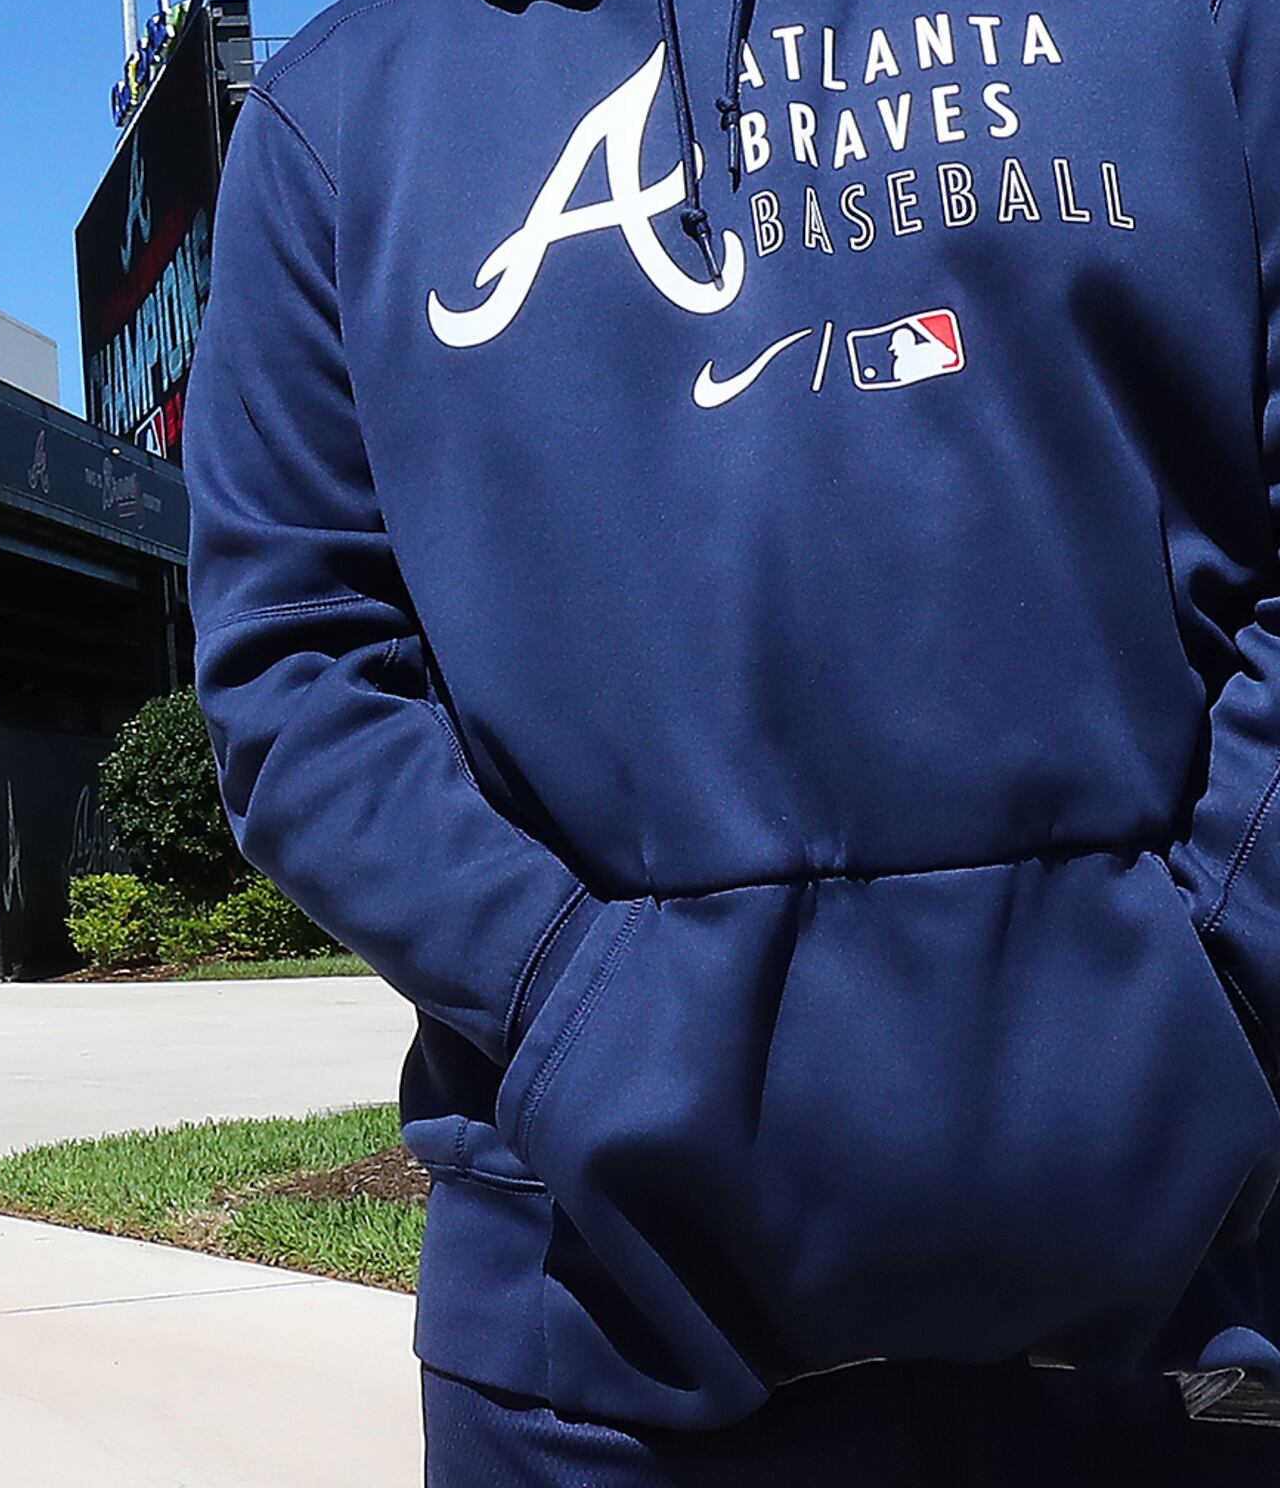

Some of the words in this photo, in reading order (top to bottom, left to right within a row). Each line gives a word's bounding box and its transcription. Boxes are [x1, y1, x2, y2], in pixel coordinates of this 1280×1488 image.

[740, 13, 1063, 90] ATLANTA
[740, 81, 1020, 174] BRAVES
[749, 158, 1136, 258] BASEBALL
